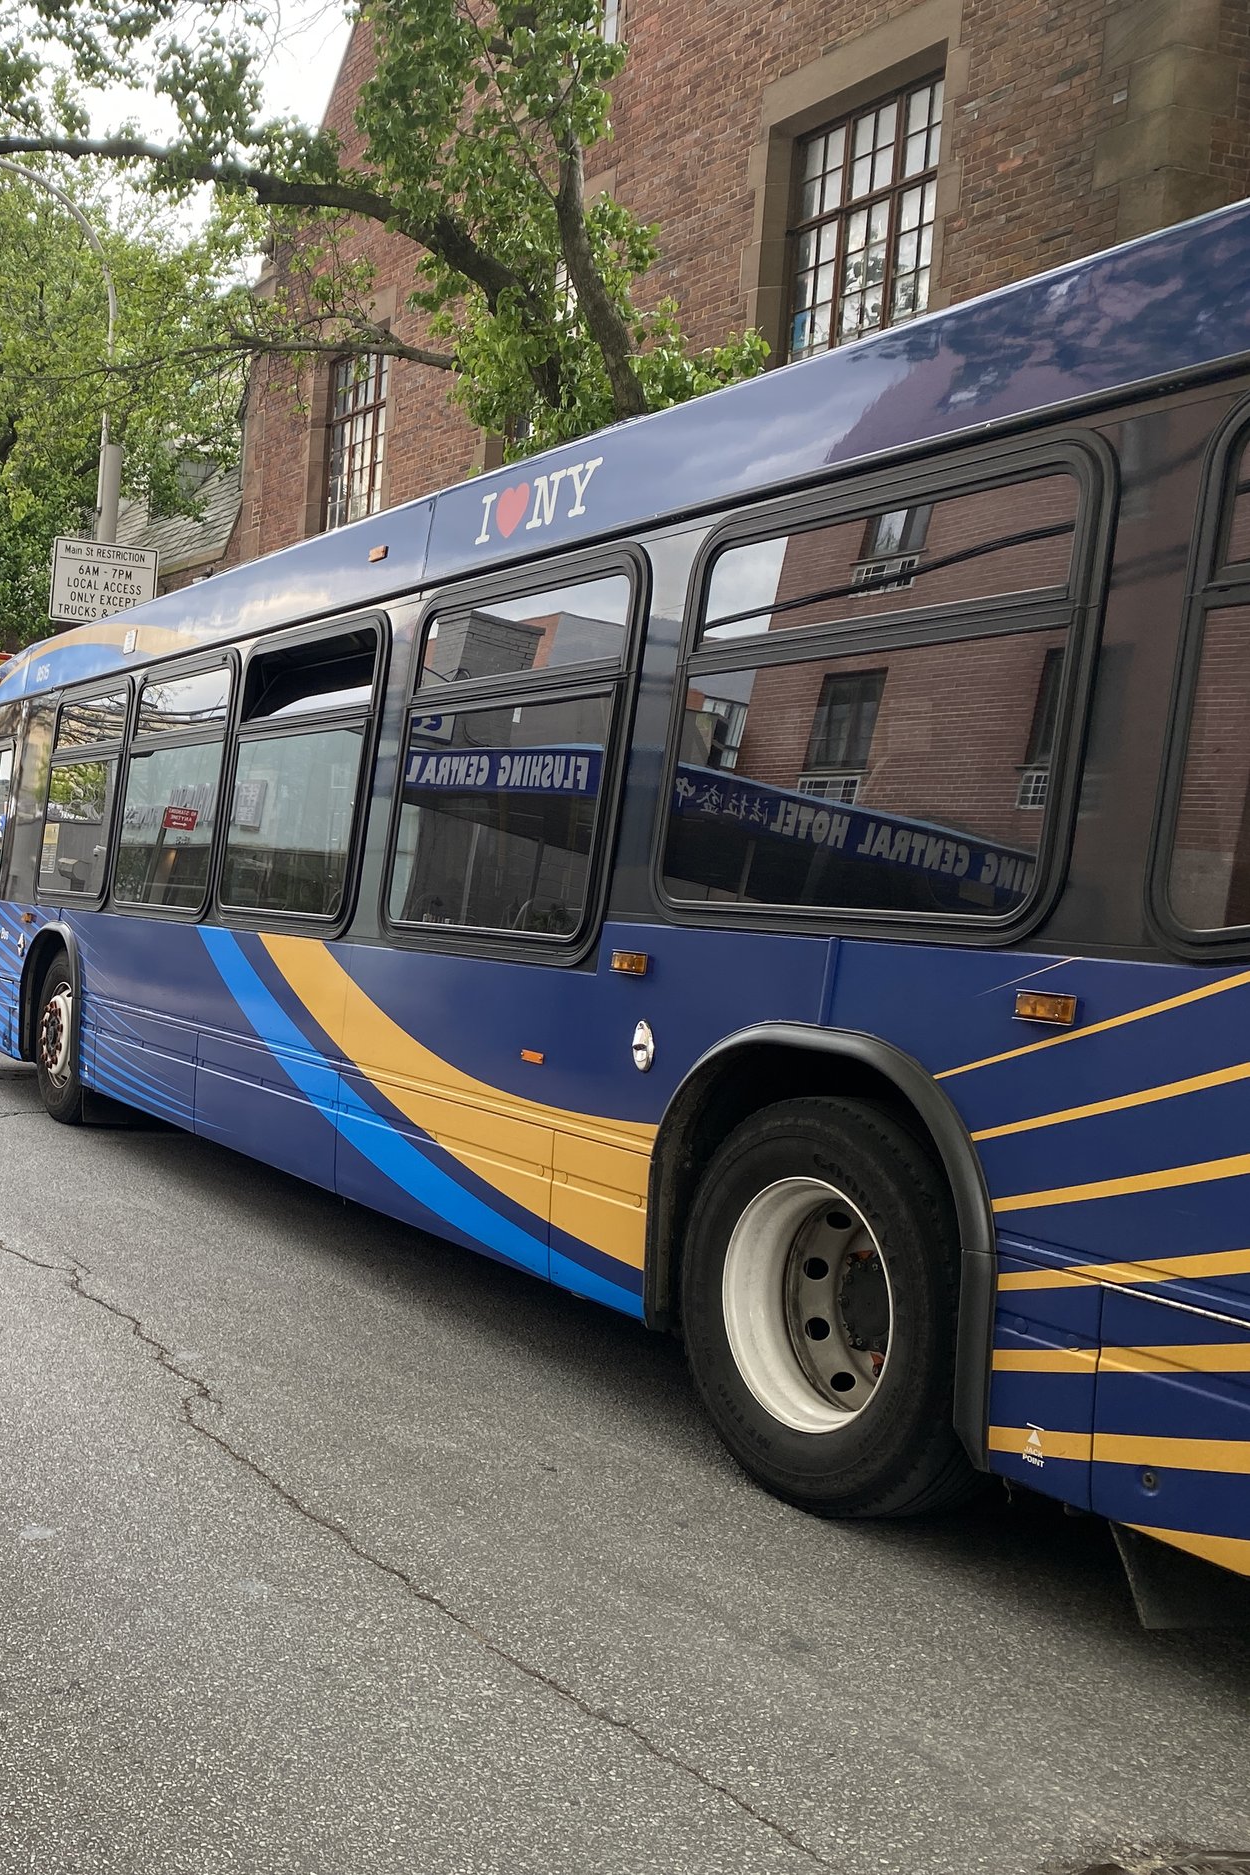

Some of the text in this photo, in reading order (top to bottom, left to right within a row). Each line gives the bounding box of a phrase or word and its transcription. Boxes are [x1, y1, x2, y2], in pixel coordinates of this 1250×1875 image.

[525, 456, 604, 530] NY
[64, 545, 145, 563] Main St RESTRICTION
[78, 565, 99, 576] 6AM
[112, 568, 132, 580] 7PM
[67, 577, 142, 596] LOCAL ACCESS
[70, 591, 137, 608] ONLY EXCEPT
[58, 603, 109, 618] TRUCKS &
[1023, 1445, 1043, 1459] JACK
[1022, 1453, 1045, 1468] POINT
